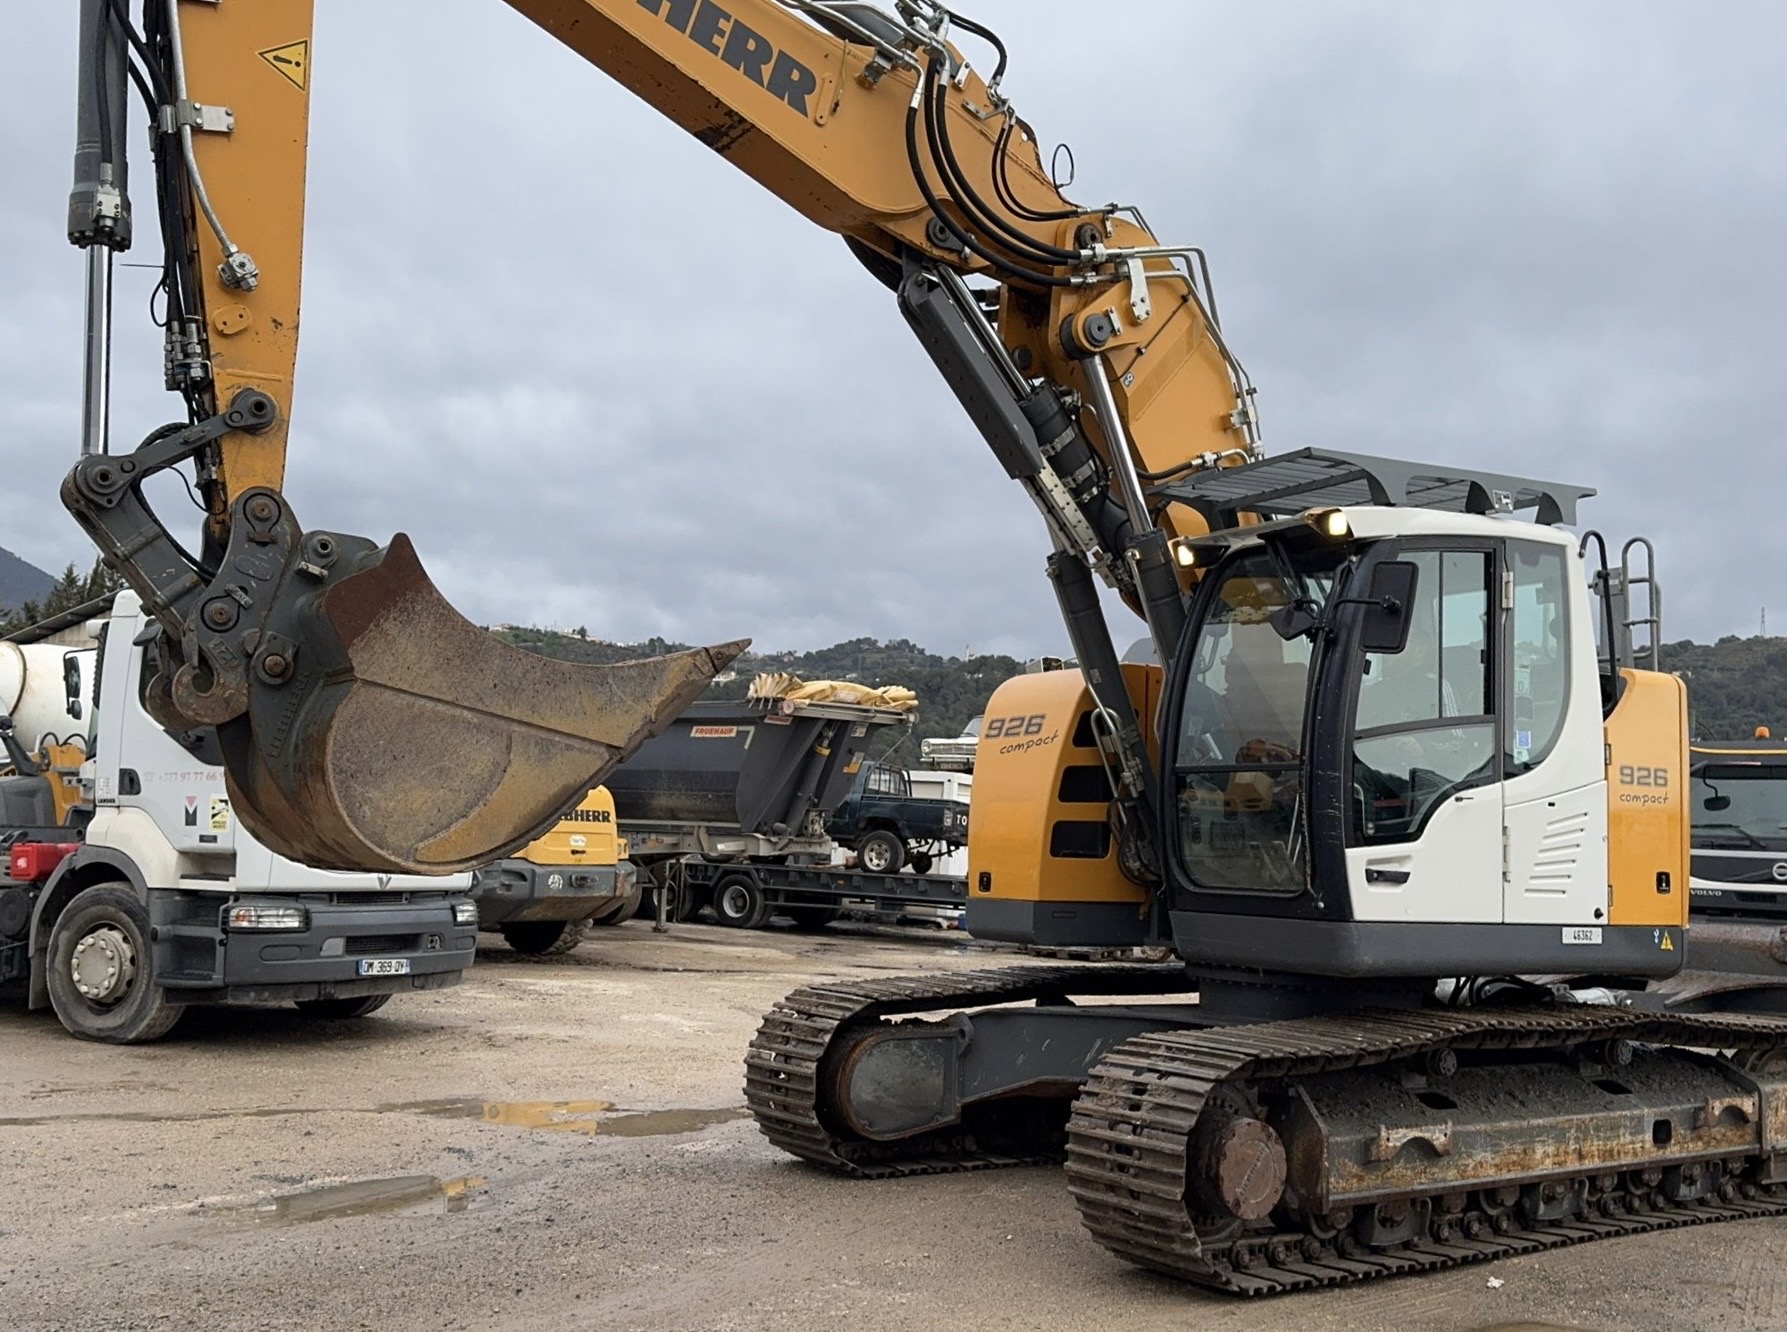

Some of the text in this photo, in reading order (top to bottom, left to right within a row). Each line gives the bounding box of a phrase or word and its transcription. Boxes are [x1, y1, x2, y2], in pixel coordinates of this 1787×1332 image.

[984, 713, 1046, 739] 926
[999, 729, 1059, 755] compact
[1619, 766, 1669, 787] 926
[1619, 791, 1669, 806] compact
[1690, 889, 1722, 897] VOLVO
